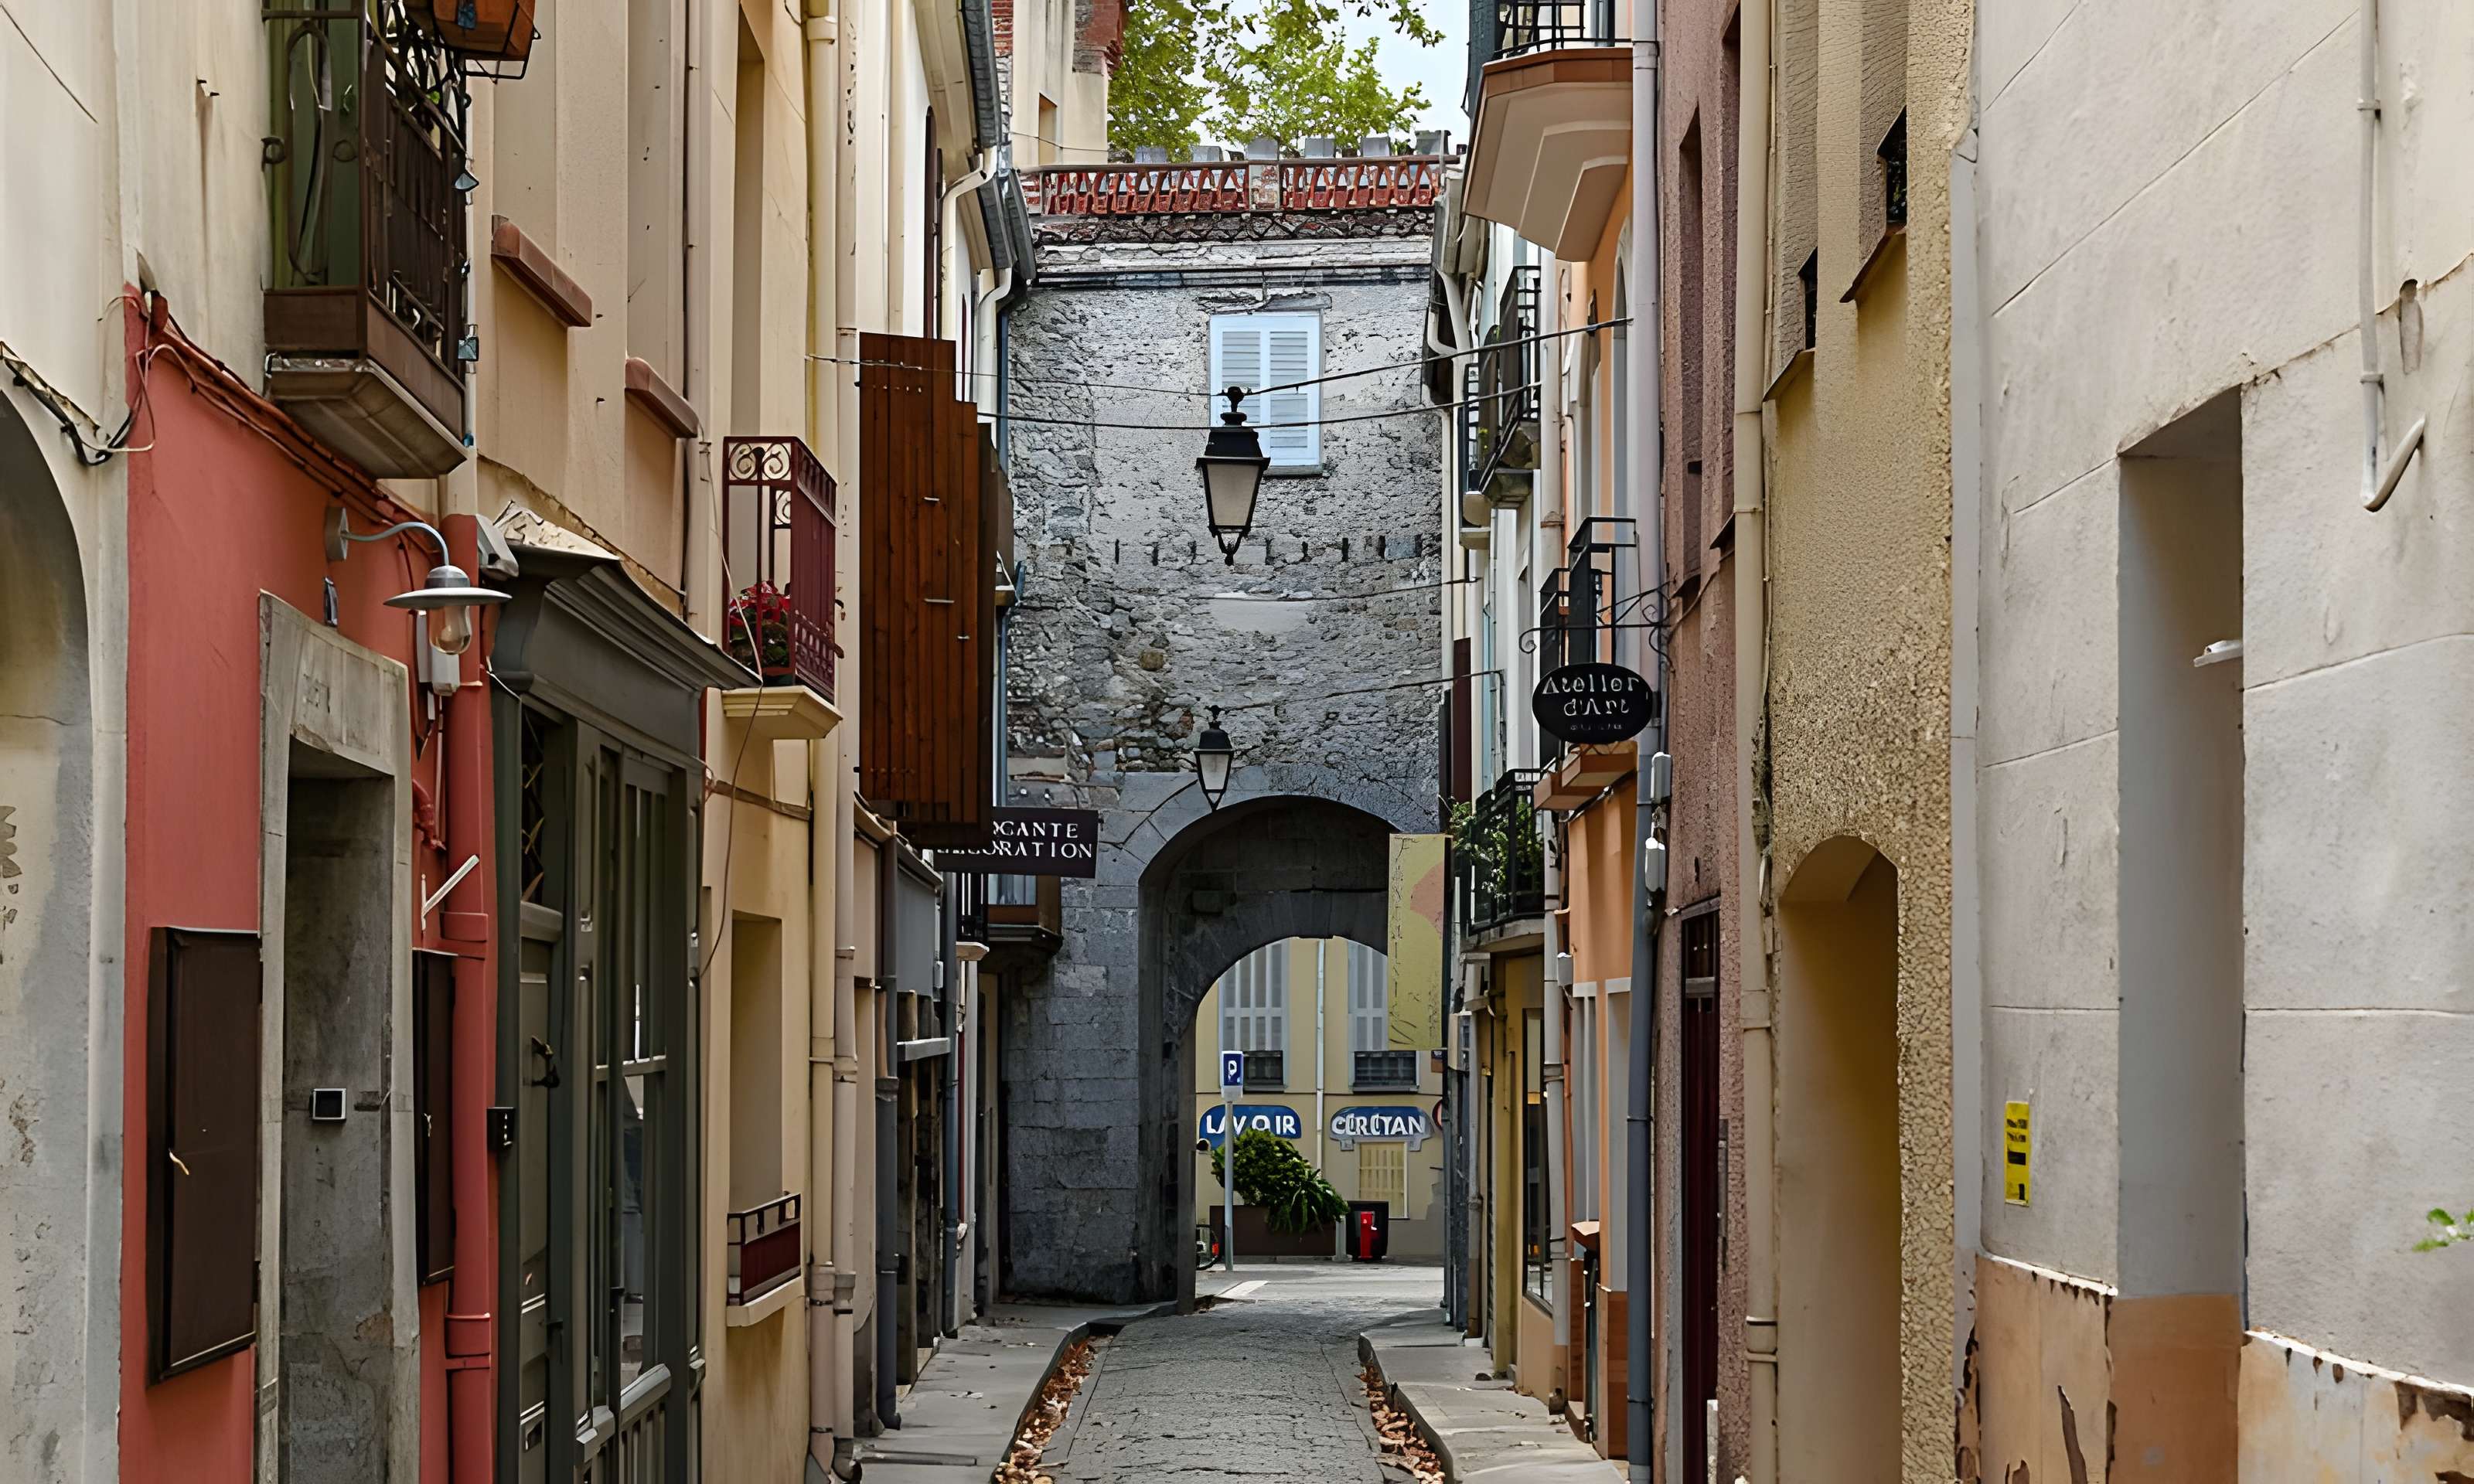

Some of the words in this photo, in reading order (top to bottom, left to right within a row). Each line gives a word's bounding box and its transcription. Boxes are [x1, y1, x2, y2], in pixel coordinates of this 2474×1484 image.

[1542, 674, 1639, 694] Atelier
[993, 821, 1079, 839] CANTE
[937, 840, 1092, 859] ORATION
[1228, 1060, 1238, 1081] P
